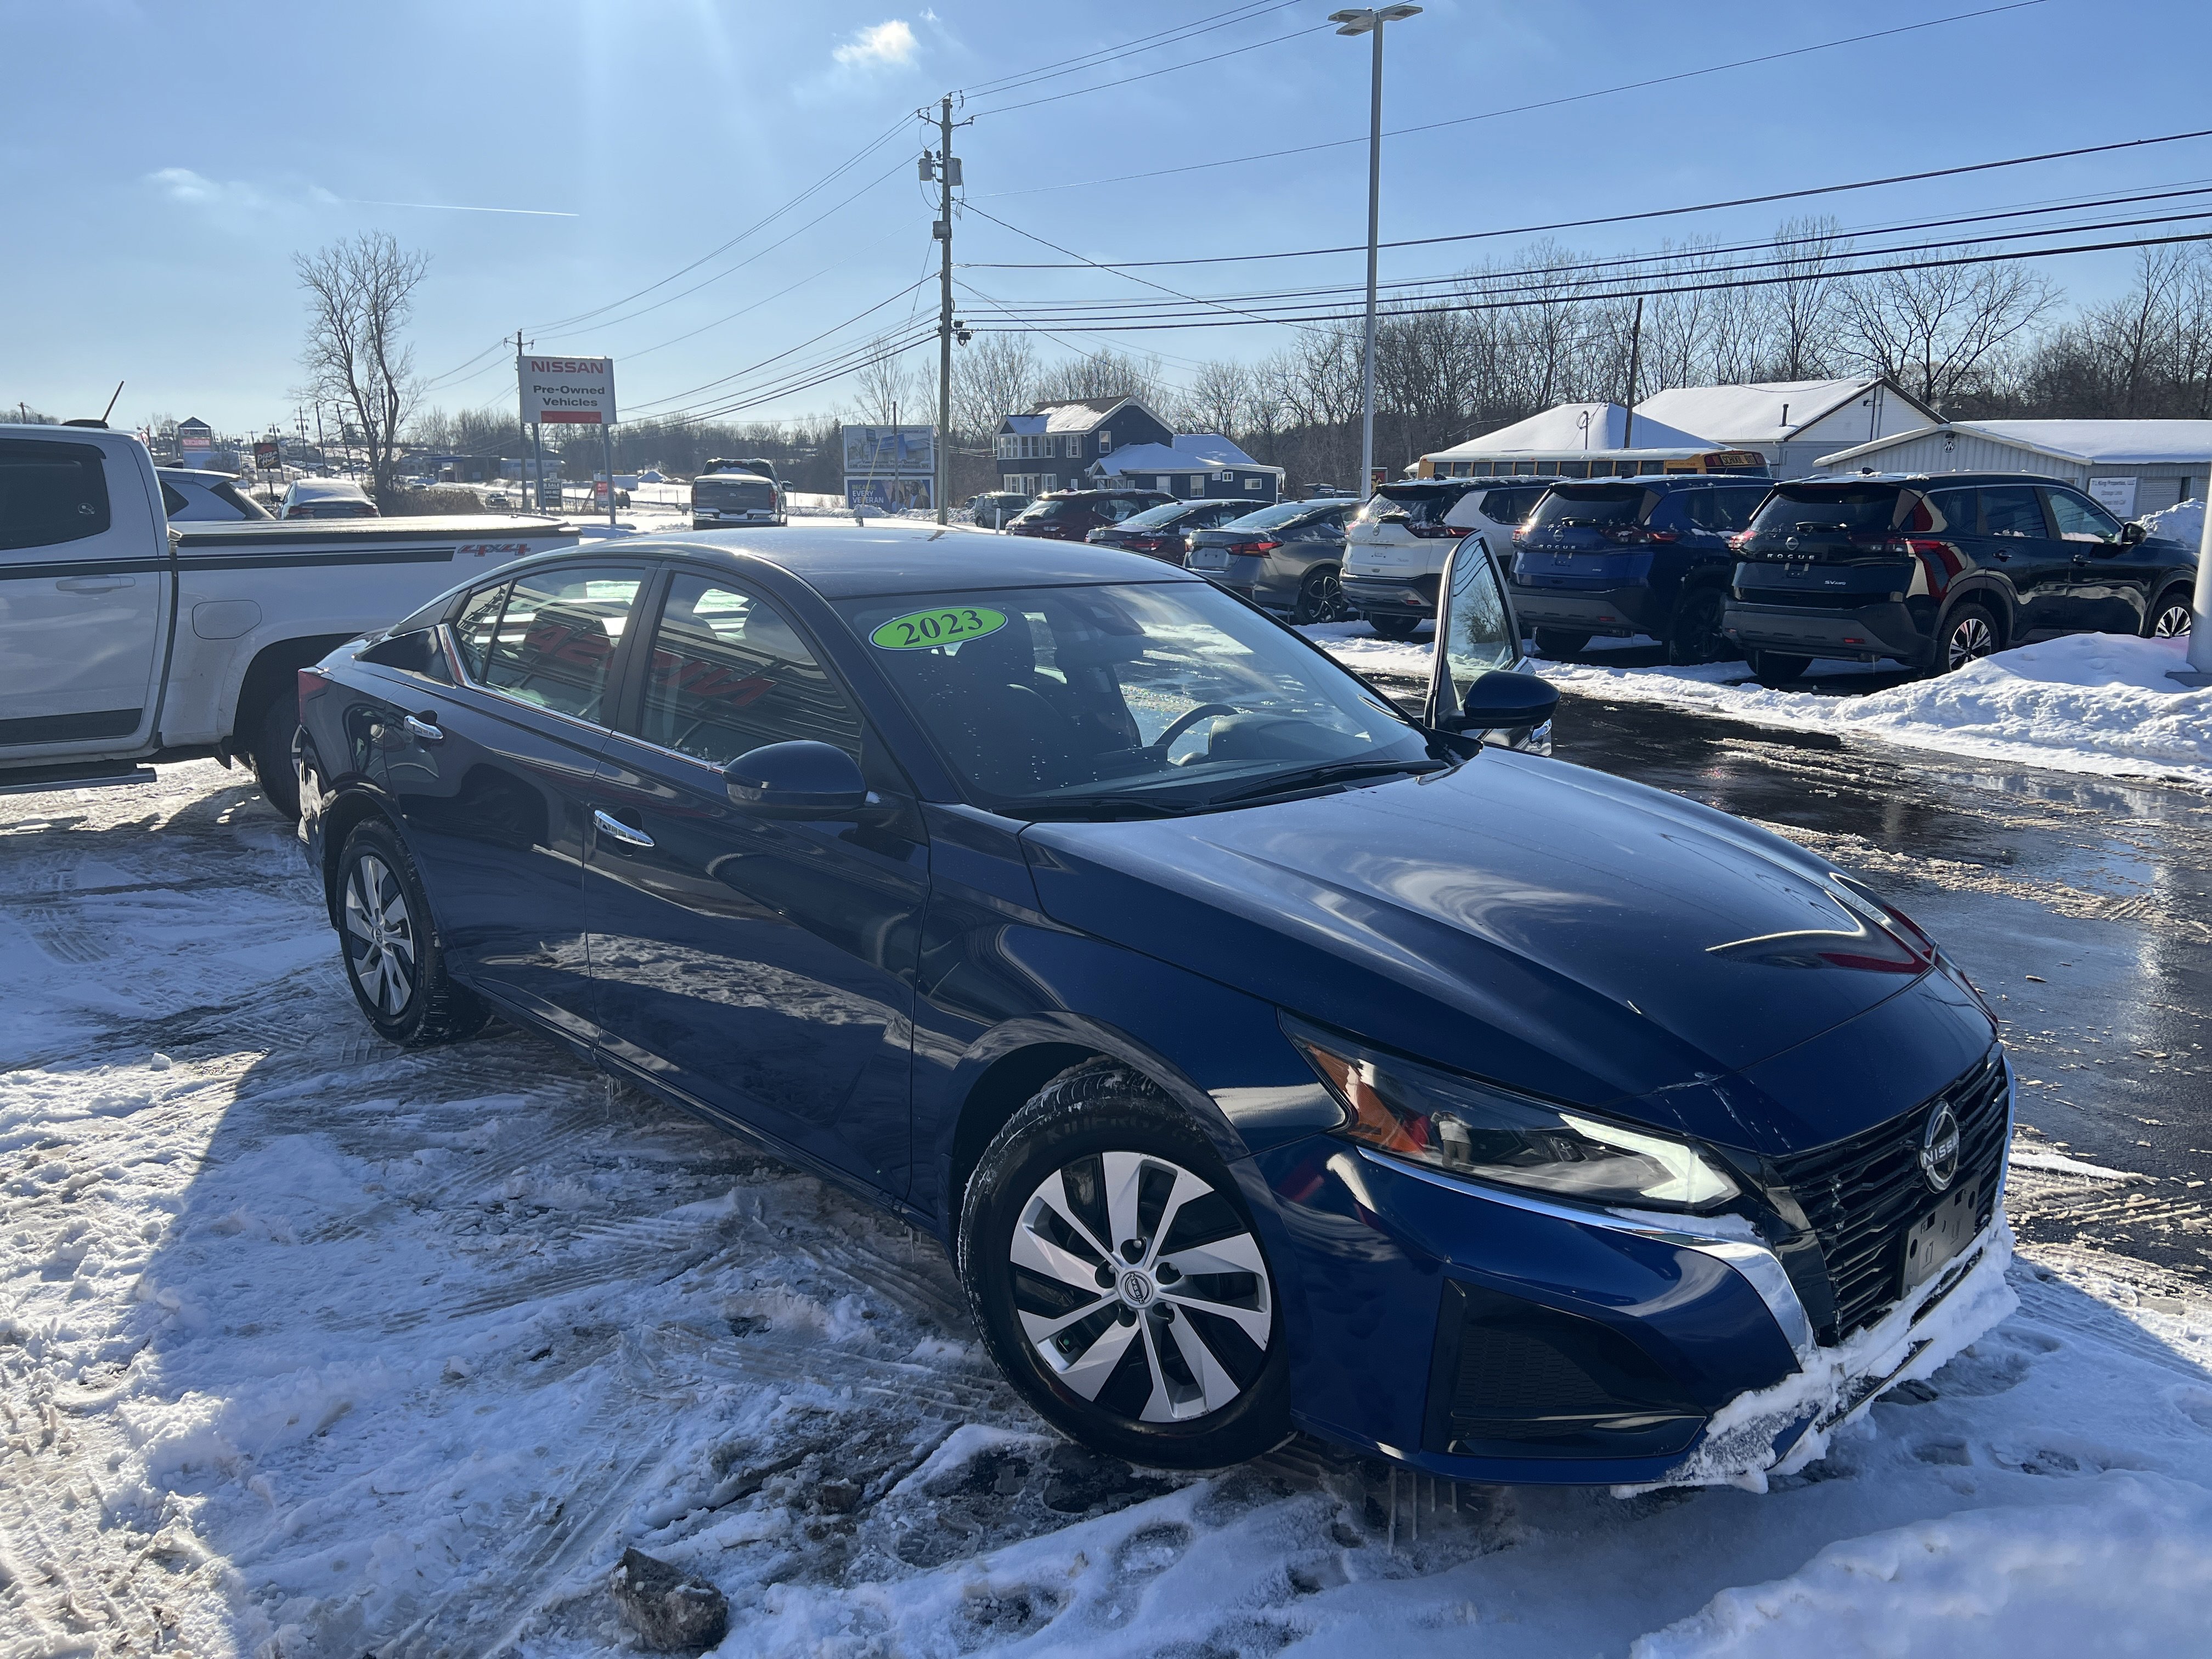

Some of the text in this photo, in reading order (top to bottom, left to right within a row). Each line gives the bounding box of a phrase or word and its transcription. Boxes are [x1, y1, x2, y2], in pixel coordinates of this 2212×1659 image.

[531, 361, 603, 374] NISSAN
[533, 385, 605, 394] Pre-Owned
[543, 398, 597, 406] Vehicles
[257, 451, 278, 464] Pizza
[261, 456, 276, 466] Hut
[1722, 455, 1745, 465] SCHOOL
[896, 610, 983, 646] 2023
[1922, 1136, 1957, 1166] NISSA
[1130, 1273, 1144, 1304] NISSAN
